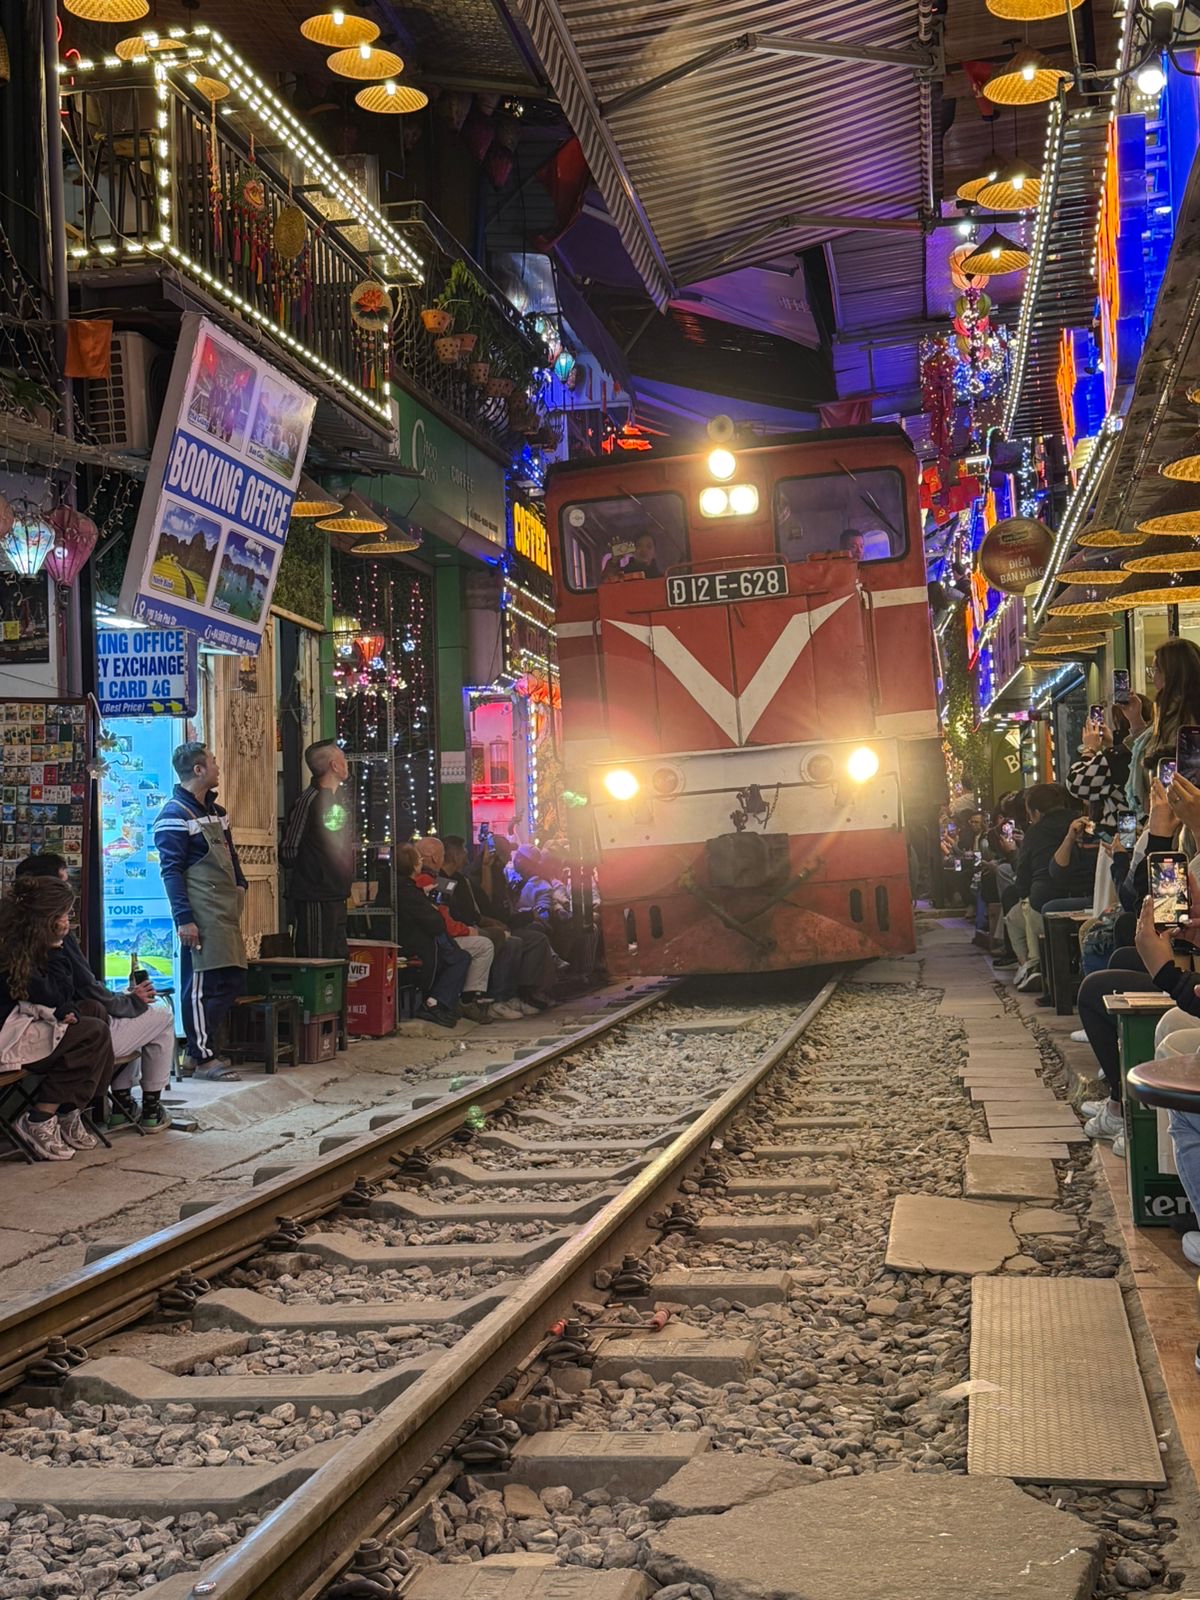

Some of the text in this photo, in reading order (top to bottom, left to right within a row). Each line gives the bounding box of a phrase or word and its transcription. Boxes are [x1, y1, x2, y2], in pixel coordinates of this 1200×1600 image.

[168, 436, 291, 538] BOOKING OFFICE
[133, 631, 184, 654] OFFICE
[113, 655, 184, 677] EXCHANGE
[109, 680, 147, 699] CARD
[152, 679, 171, 697] 4G
[102, 700, 145, 713] (Best Price)
[108, 905, 144, 915] TOURS
